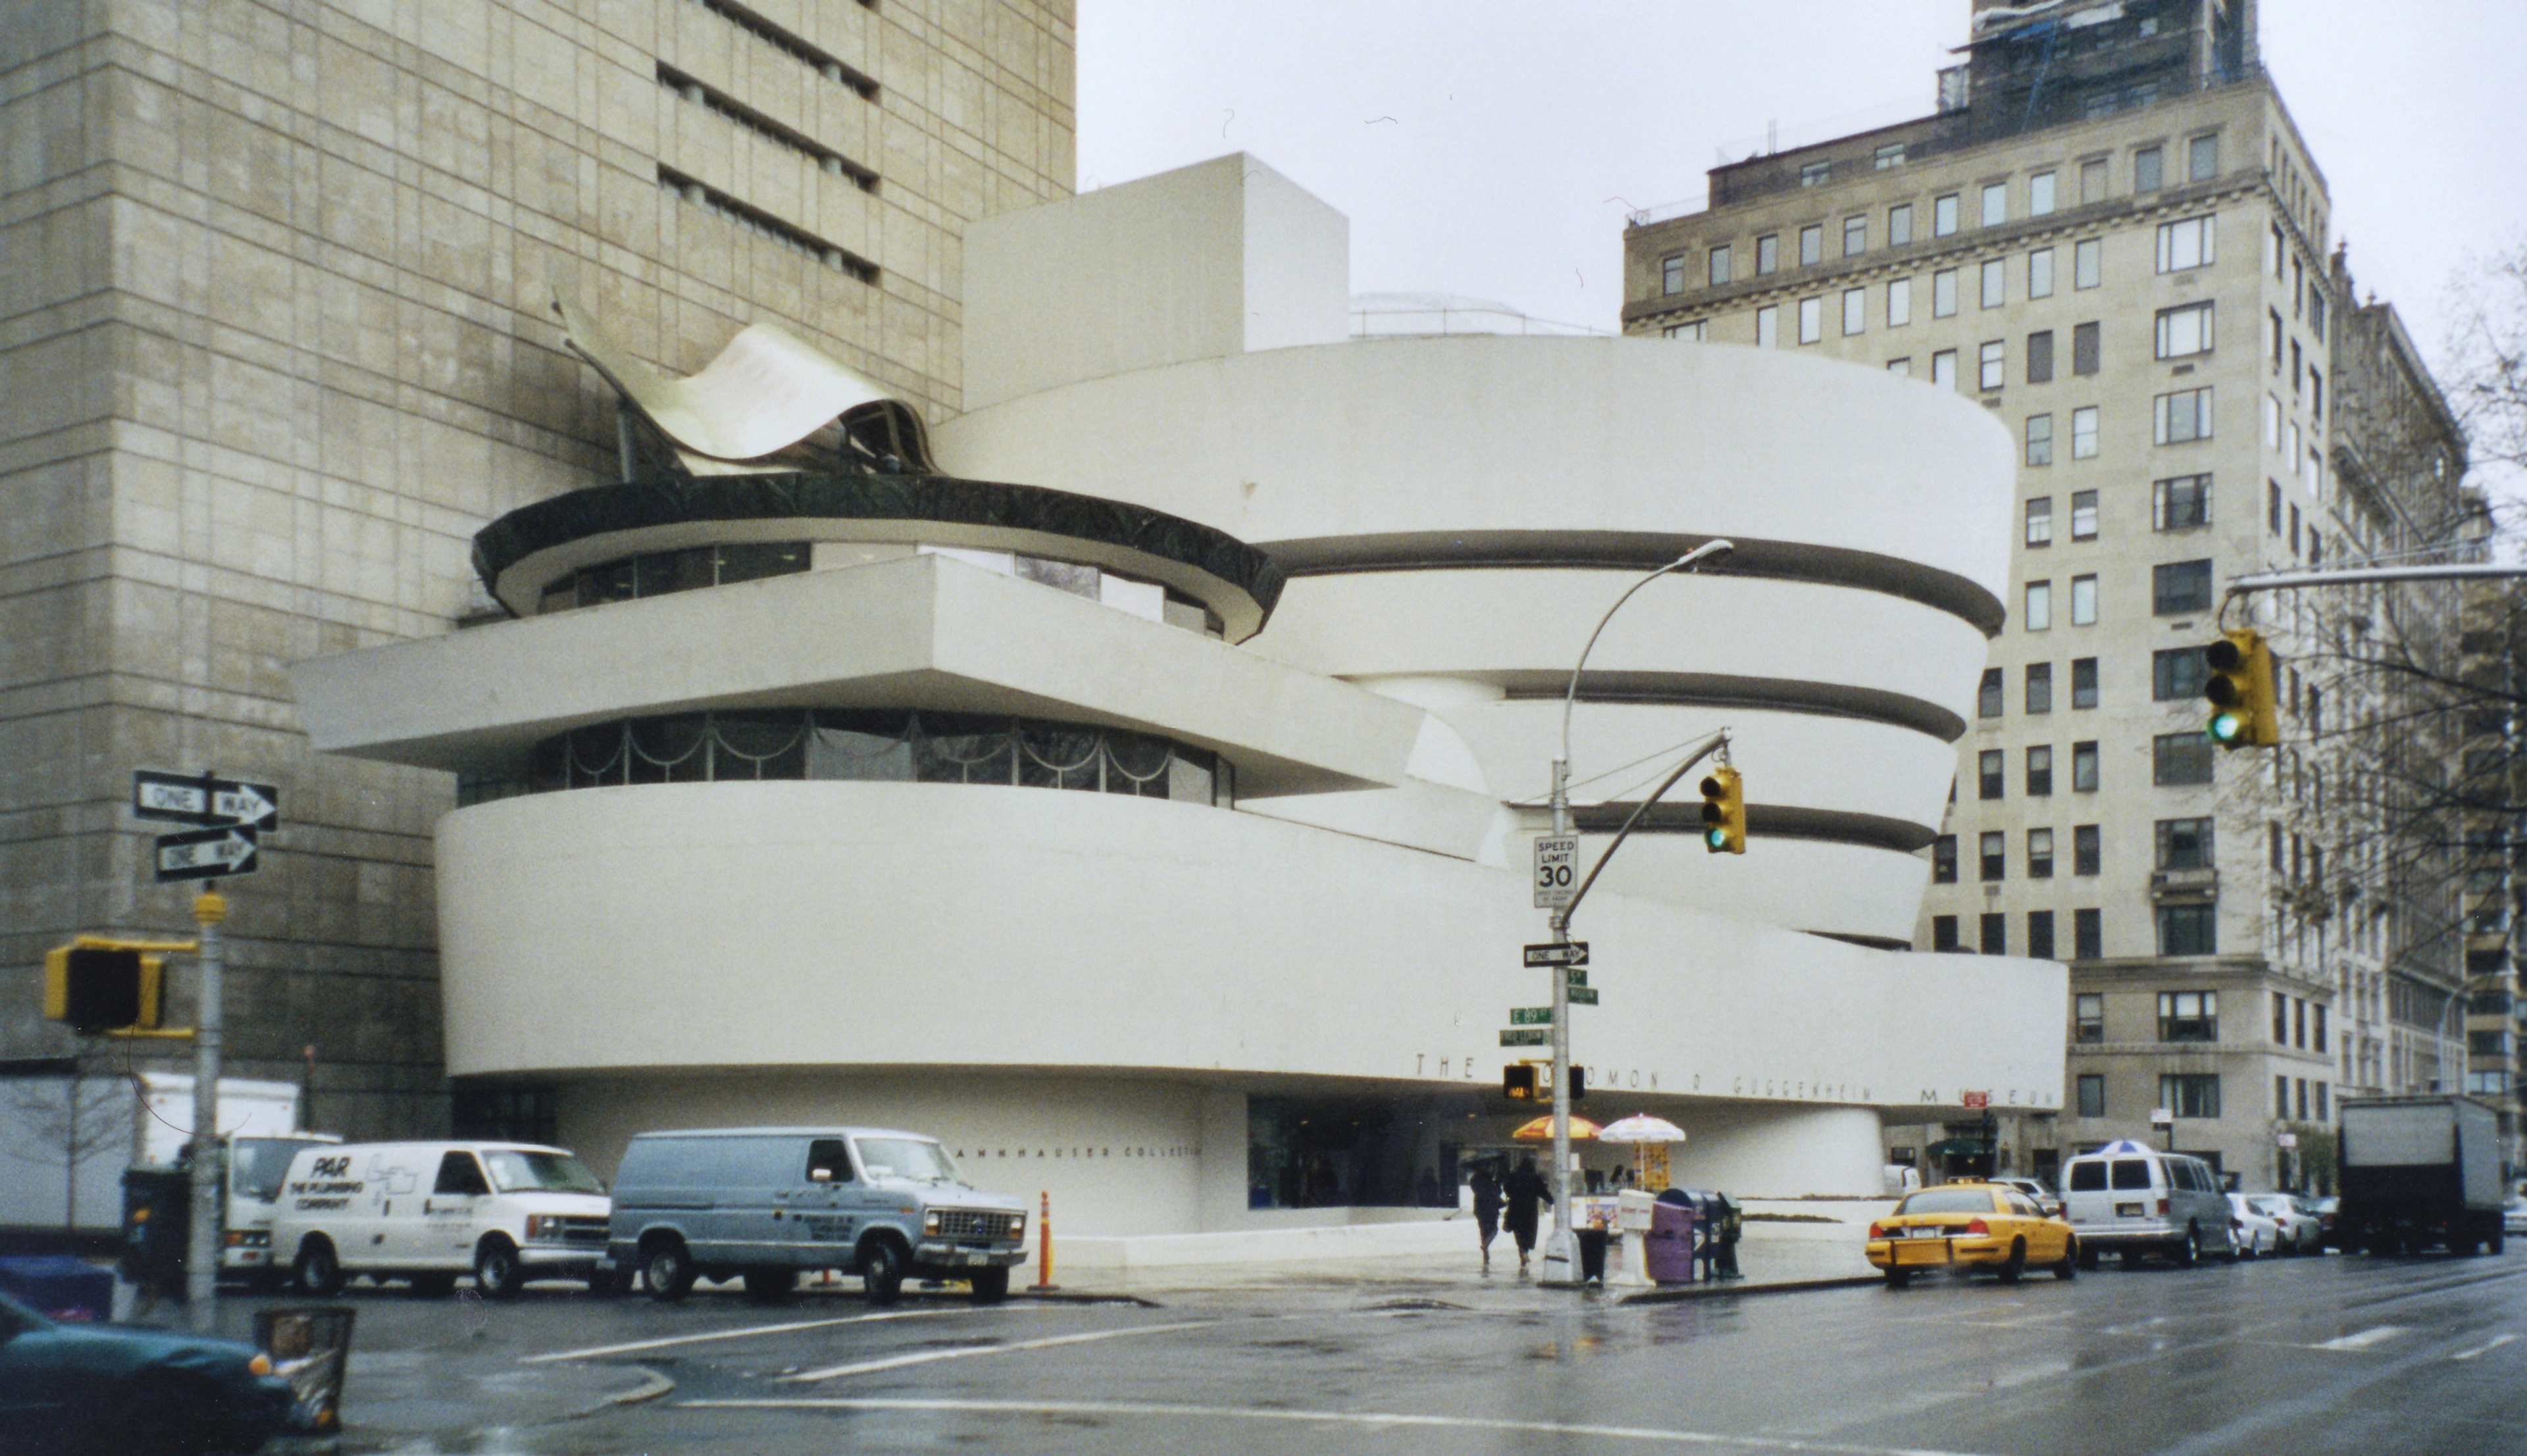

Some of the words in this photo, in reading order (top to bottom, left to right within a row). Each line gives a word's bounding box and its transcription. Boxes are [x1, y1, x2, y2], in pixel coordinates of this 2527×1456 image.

[155, 787, 194, 809] ONE
[221, 795, 260, 813] WAY
[169, 846, 195, 866] ONE
[215, 841, 244, 857] WAY
[1539, 841, 1575, 851] SPEED
[1542, 853, 1569, 863] LIMIT
[1539, 865, 1572, 888] 30
[1532, 950, 1550, 961] ONE
[1562, 949, 1579, 960] WAY
[1514, 1009, 1520, 1024] E
[1524, 1009, 1538, 1023] 89
[1417, 1053, 1473, 1078] THE
[1734, 1076, 1871, 1101] GUGGENHEIM
[956, 1146, 1109, 1158] ANNHAUSER
[309, 1156, 352, 1178] PAR
[309, 1181, 364, 1195] PLUMBING
